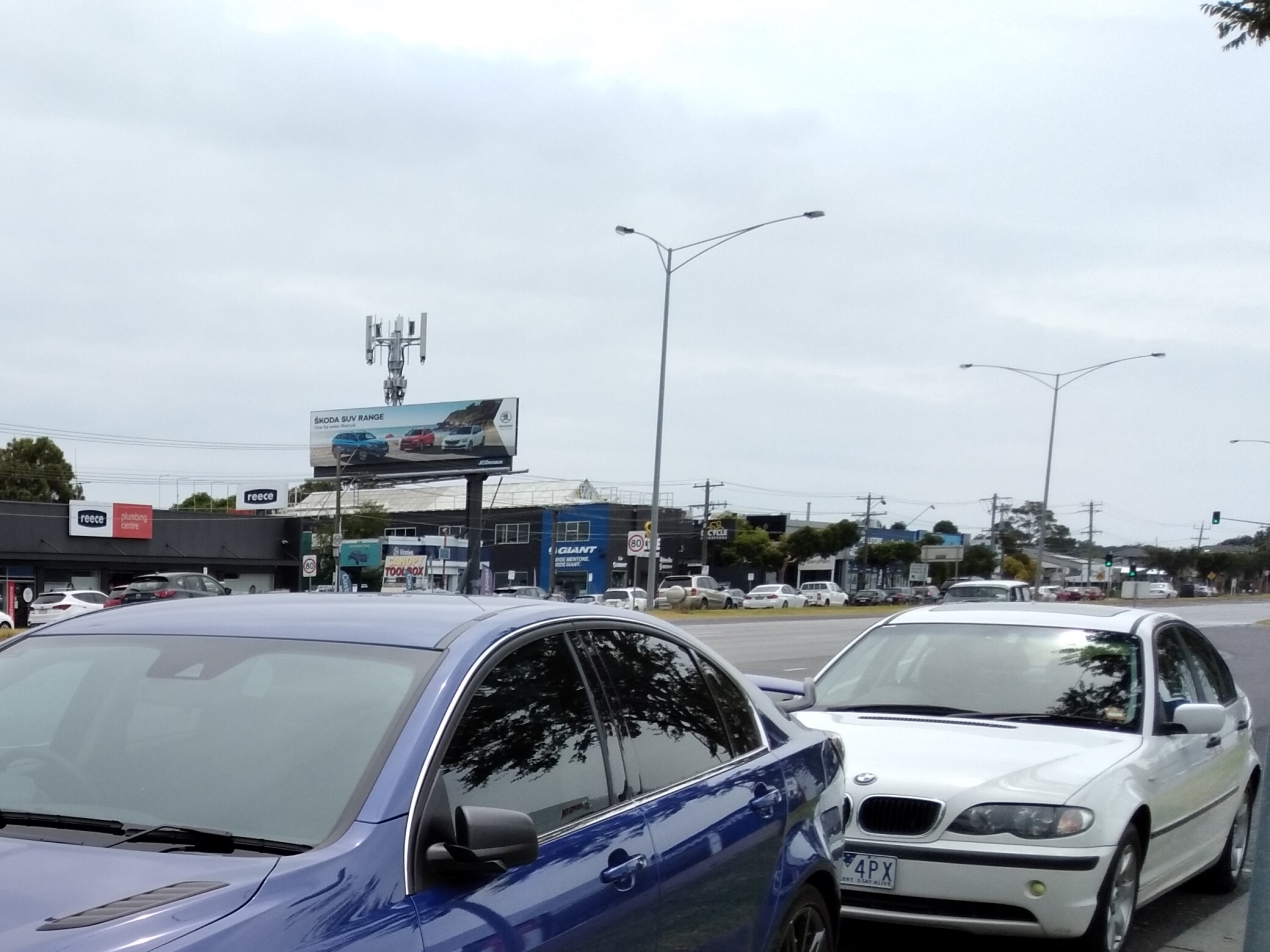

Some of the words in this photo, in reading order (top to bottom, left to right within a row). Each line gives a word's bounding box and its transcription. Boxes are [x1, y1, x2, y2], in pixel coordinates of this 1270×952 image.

[341, 415, 357, 423] SUV
[358, 413, 384, 421] RANGE
[247, 492, 274, 501] reece
[80, 513, 104, 524] reece
[121, 513, 148, 523] plumbing
[121, 521, 139, 530] centre
[631, 539, 642, 548] 80
[557, 546, 597, 554] GIANT
[305, 562, 314, 570] 80
[389, 557, 424, 567] CANOPY
